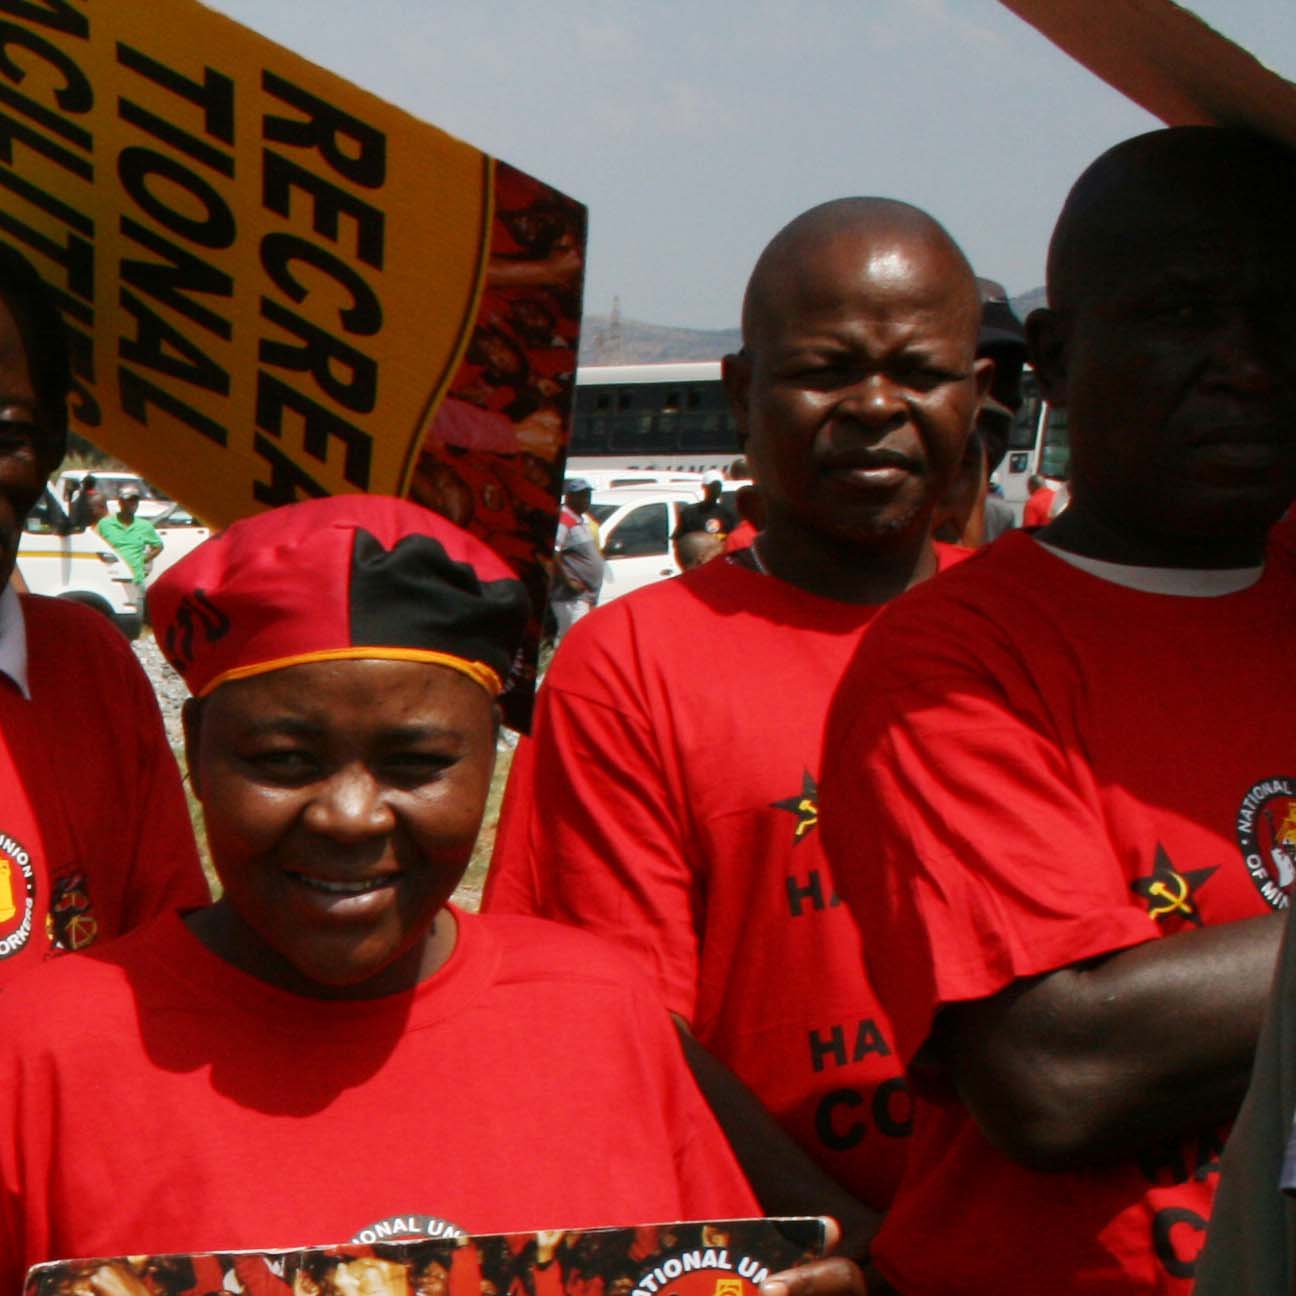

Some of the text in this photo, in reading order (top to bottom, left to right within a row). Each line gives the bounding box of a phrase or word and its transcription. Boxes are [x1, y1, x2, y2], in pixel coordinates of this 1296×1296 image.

[116, 40, 236, 448] TIONAL
[1237, 779, 1292, 833] NATIONAL
[1246, 854, 1268, 879] OF
